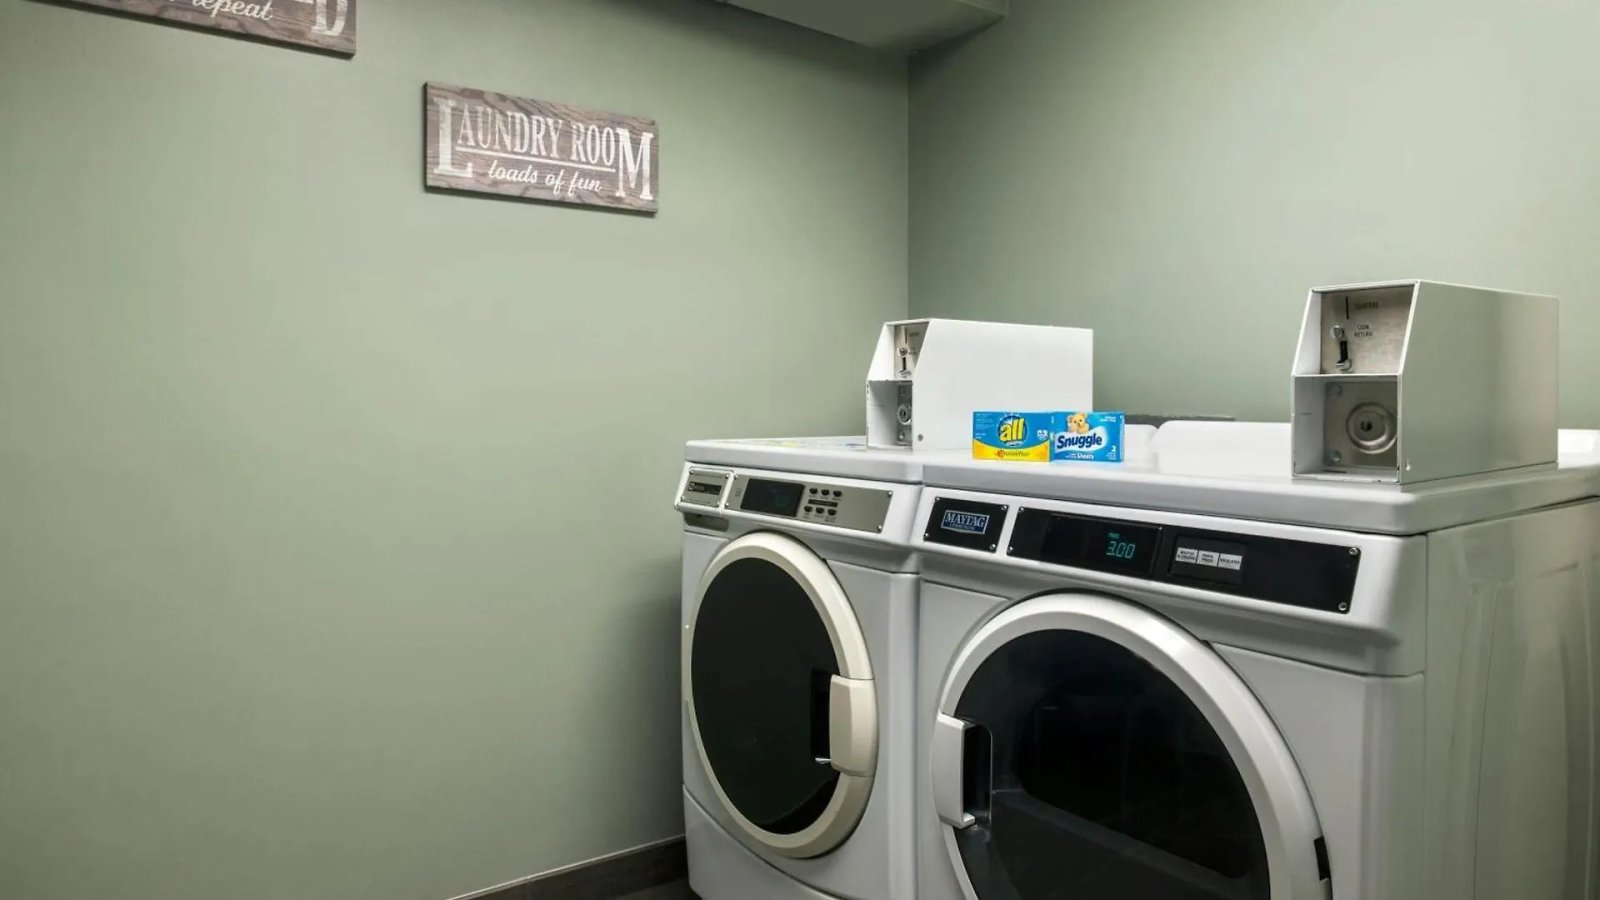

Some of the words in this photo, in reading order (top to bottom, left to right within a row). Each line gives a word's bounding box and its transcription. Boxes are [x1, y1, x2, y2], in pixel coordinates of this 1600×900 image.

[433, 97, 563, 179] LAUNDRY
[570, 122, 655, 201] ROOM
[488, 160, 538, 184] loads
[545, 172, 565, 195] of
[567, 171, 603, 197] fun
[999, 417, 1025, 443] all
[1057, 433, 1103, 449] Snuggle
[945, 512, 986, 528] MAYTAG
